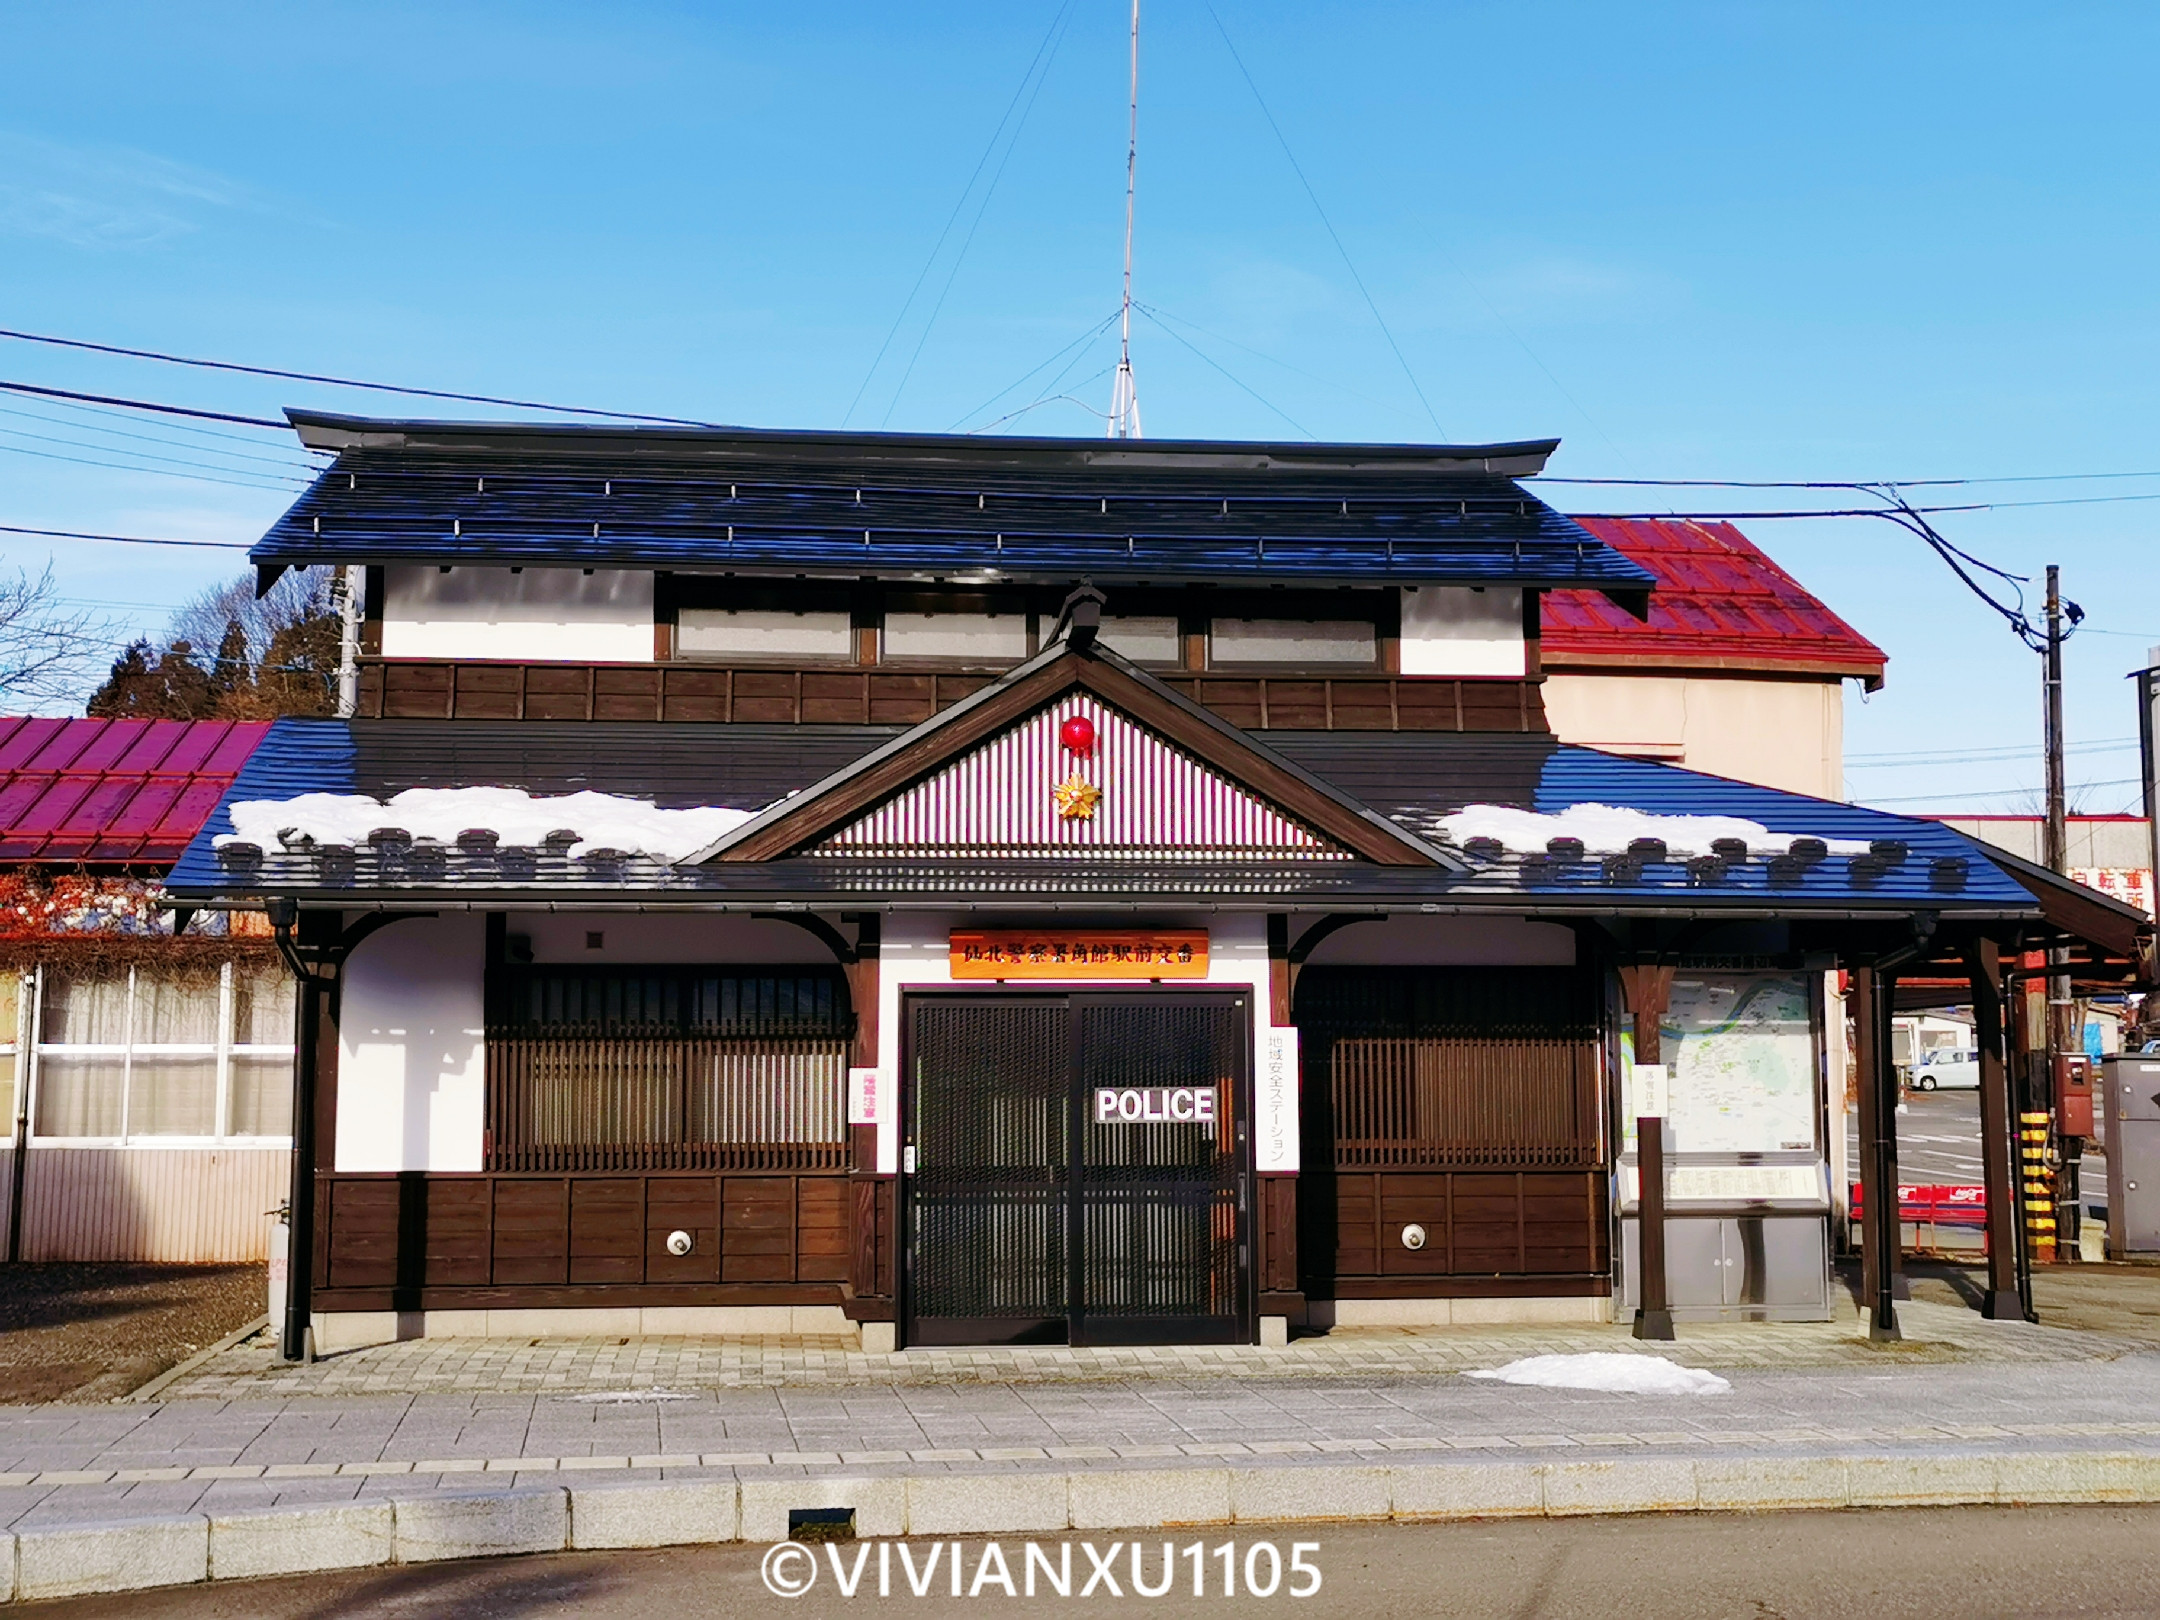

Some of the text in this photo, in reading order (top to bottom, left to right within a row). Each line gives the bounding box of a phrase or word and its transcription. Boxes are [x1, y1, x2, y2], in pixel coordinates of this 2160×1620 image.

[964, 943, 1193, 964] 仙北警察署角館駅前交番
[1098, 1089, 1214, 1121] POLICE
[1268, 1035, 1284, 1162] 地域安全ステーション
